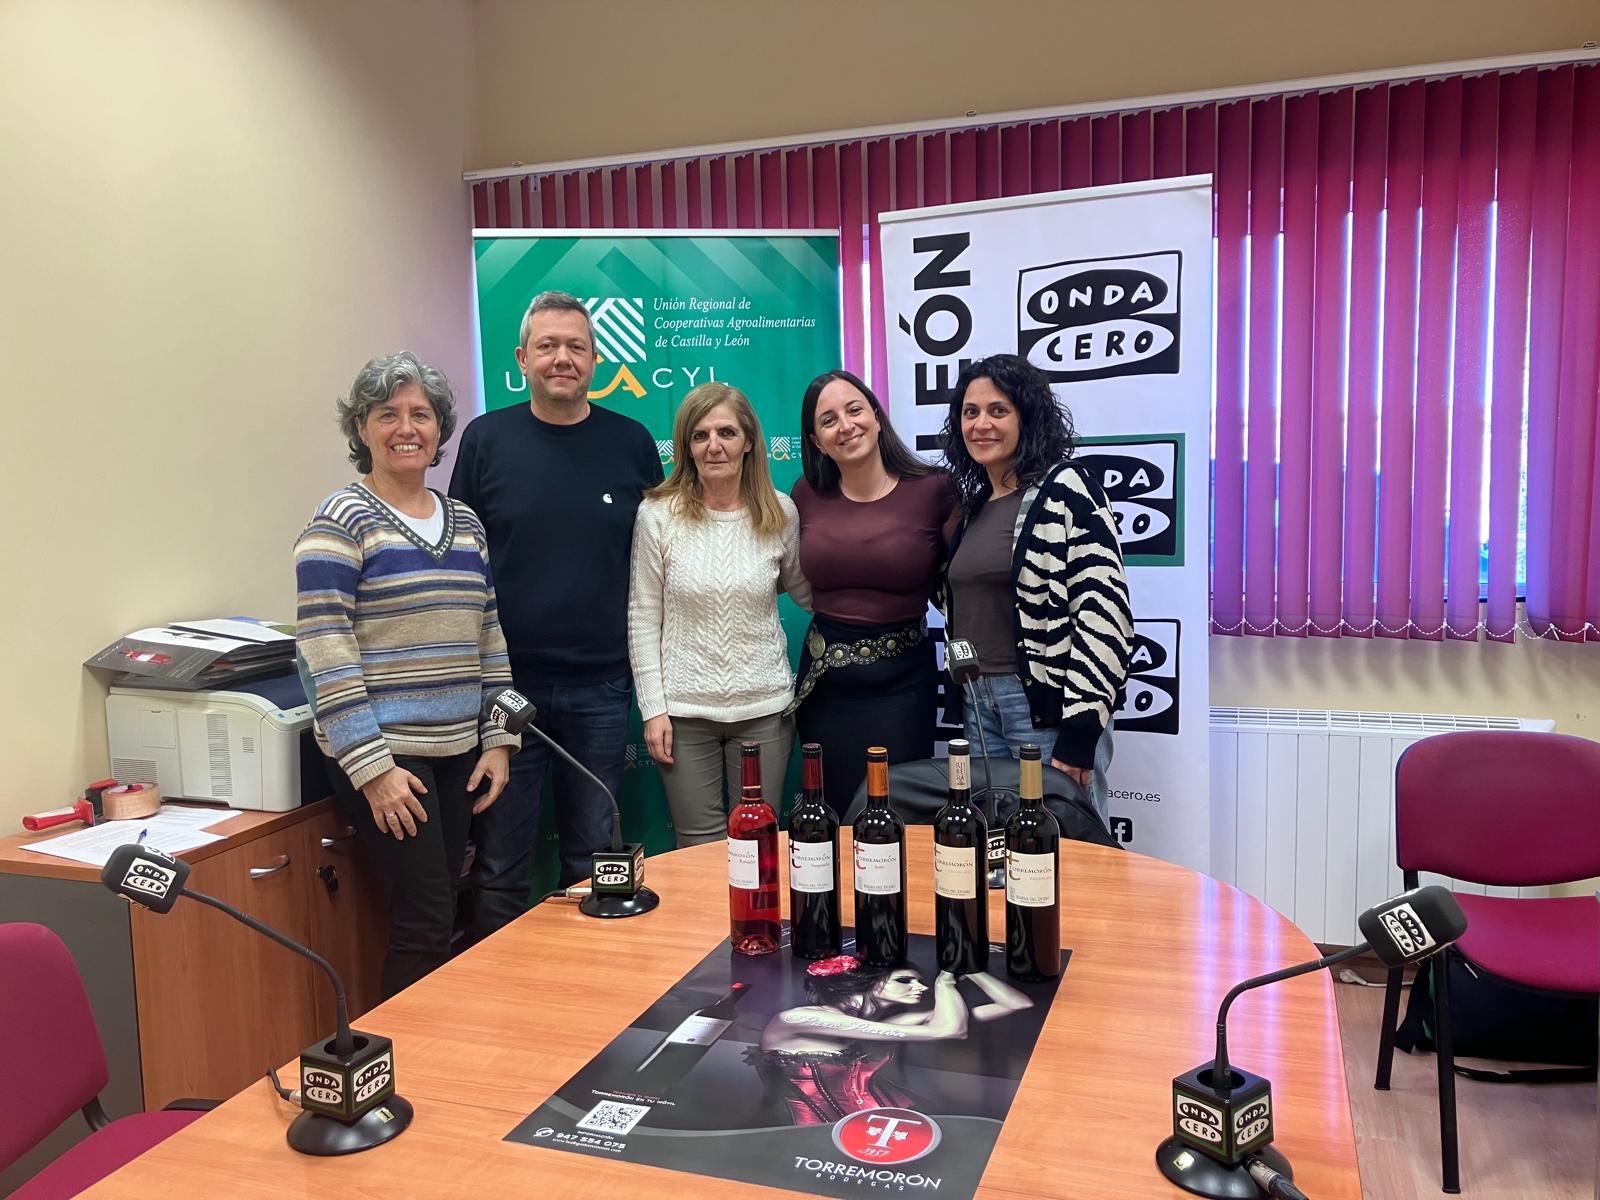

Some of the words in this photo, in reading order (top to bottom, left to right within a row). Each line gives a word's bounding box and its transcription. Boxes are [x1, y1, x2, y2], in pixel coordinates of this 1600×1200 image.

[653, 297, 686, 310] Unión
[689, 296, 735, 313] Regional
[738, 297, 751, 310] de
[1040, 281, 1154, 314] ONDA
[654, 317, 724, 331] Cooperativas
[727, 316, 816, 331] Agroalimentarias
[655, 336, 668, 348] de
[671, 335, 712, 347] Castilla
[715, 338, 722, 349] y
[724, 334, 750, 346] León
[1046, 330, 1154, 362] CERO
[1103, 468, 1151, 488] DA
[1111, 511, 1151, 535] RO
[1107, 789, 1161, 803] acero.es
[987, 840, 1005, 849] OND
[137, 866, 166, 881] ONDA
[133, 877, 162, 891] CERO
[1390, 919, 1411, 948] CERO
[1400, 912, 1423, 943] ONDA
[309, 1074, 337, 1087] ONDA
[358, 1063, 386, 1084] ONDA
[361, 1076, 386, 1095] CERO
[311, 1090, 337, 1101] CERO
[1182, 1104, 1216, 1124] ONDA
[1239, 1106, 1265, 1126] ONDA
[555, 1132, 579, 1140] 947
[1185, 1120, 1216, 1139] CERO
[1241, 1121, 1265, 1140] CERO
[794, 1156, 942, 1190] TORREMORÓN
[815, 1172, 905, 1191] BODEGAS
